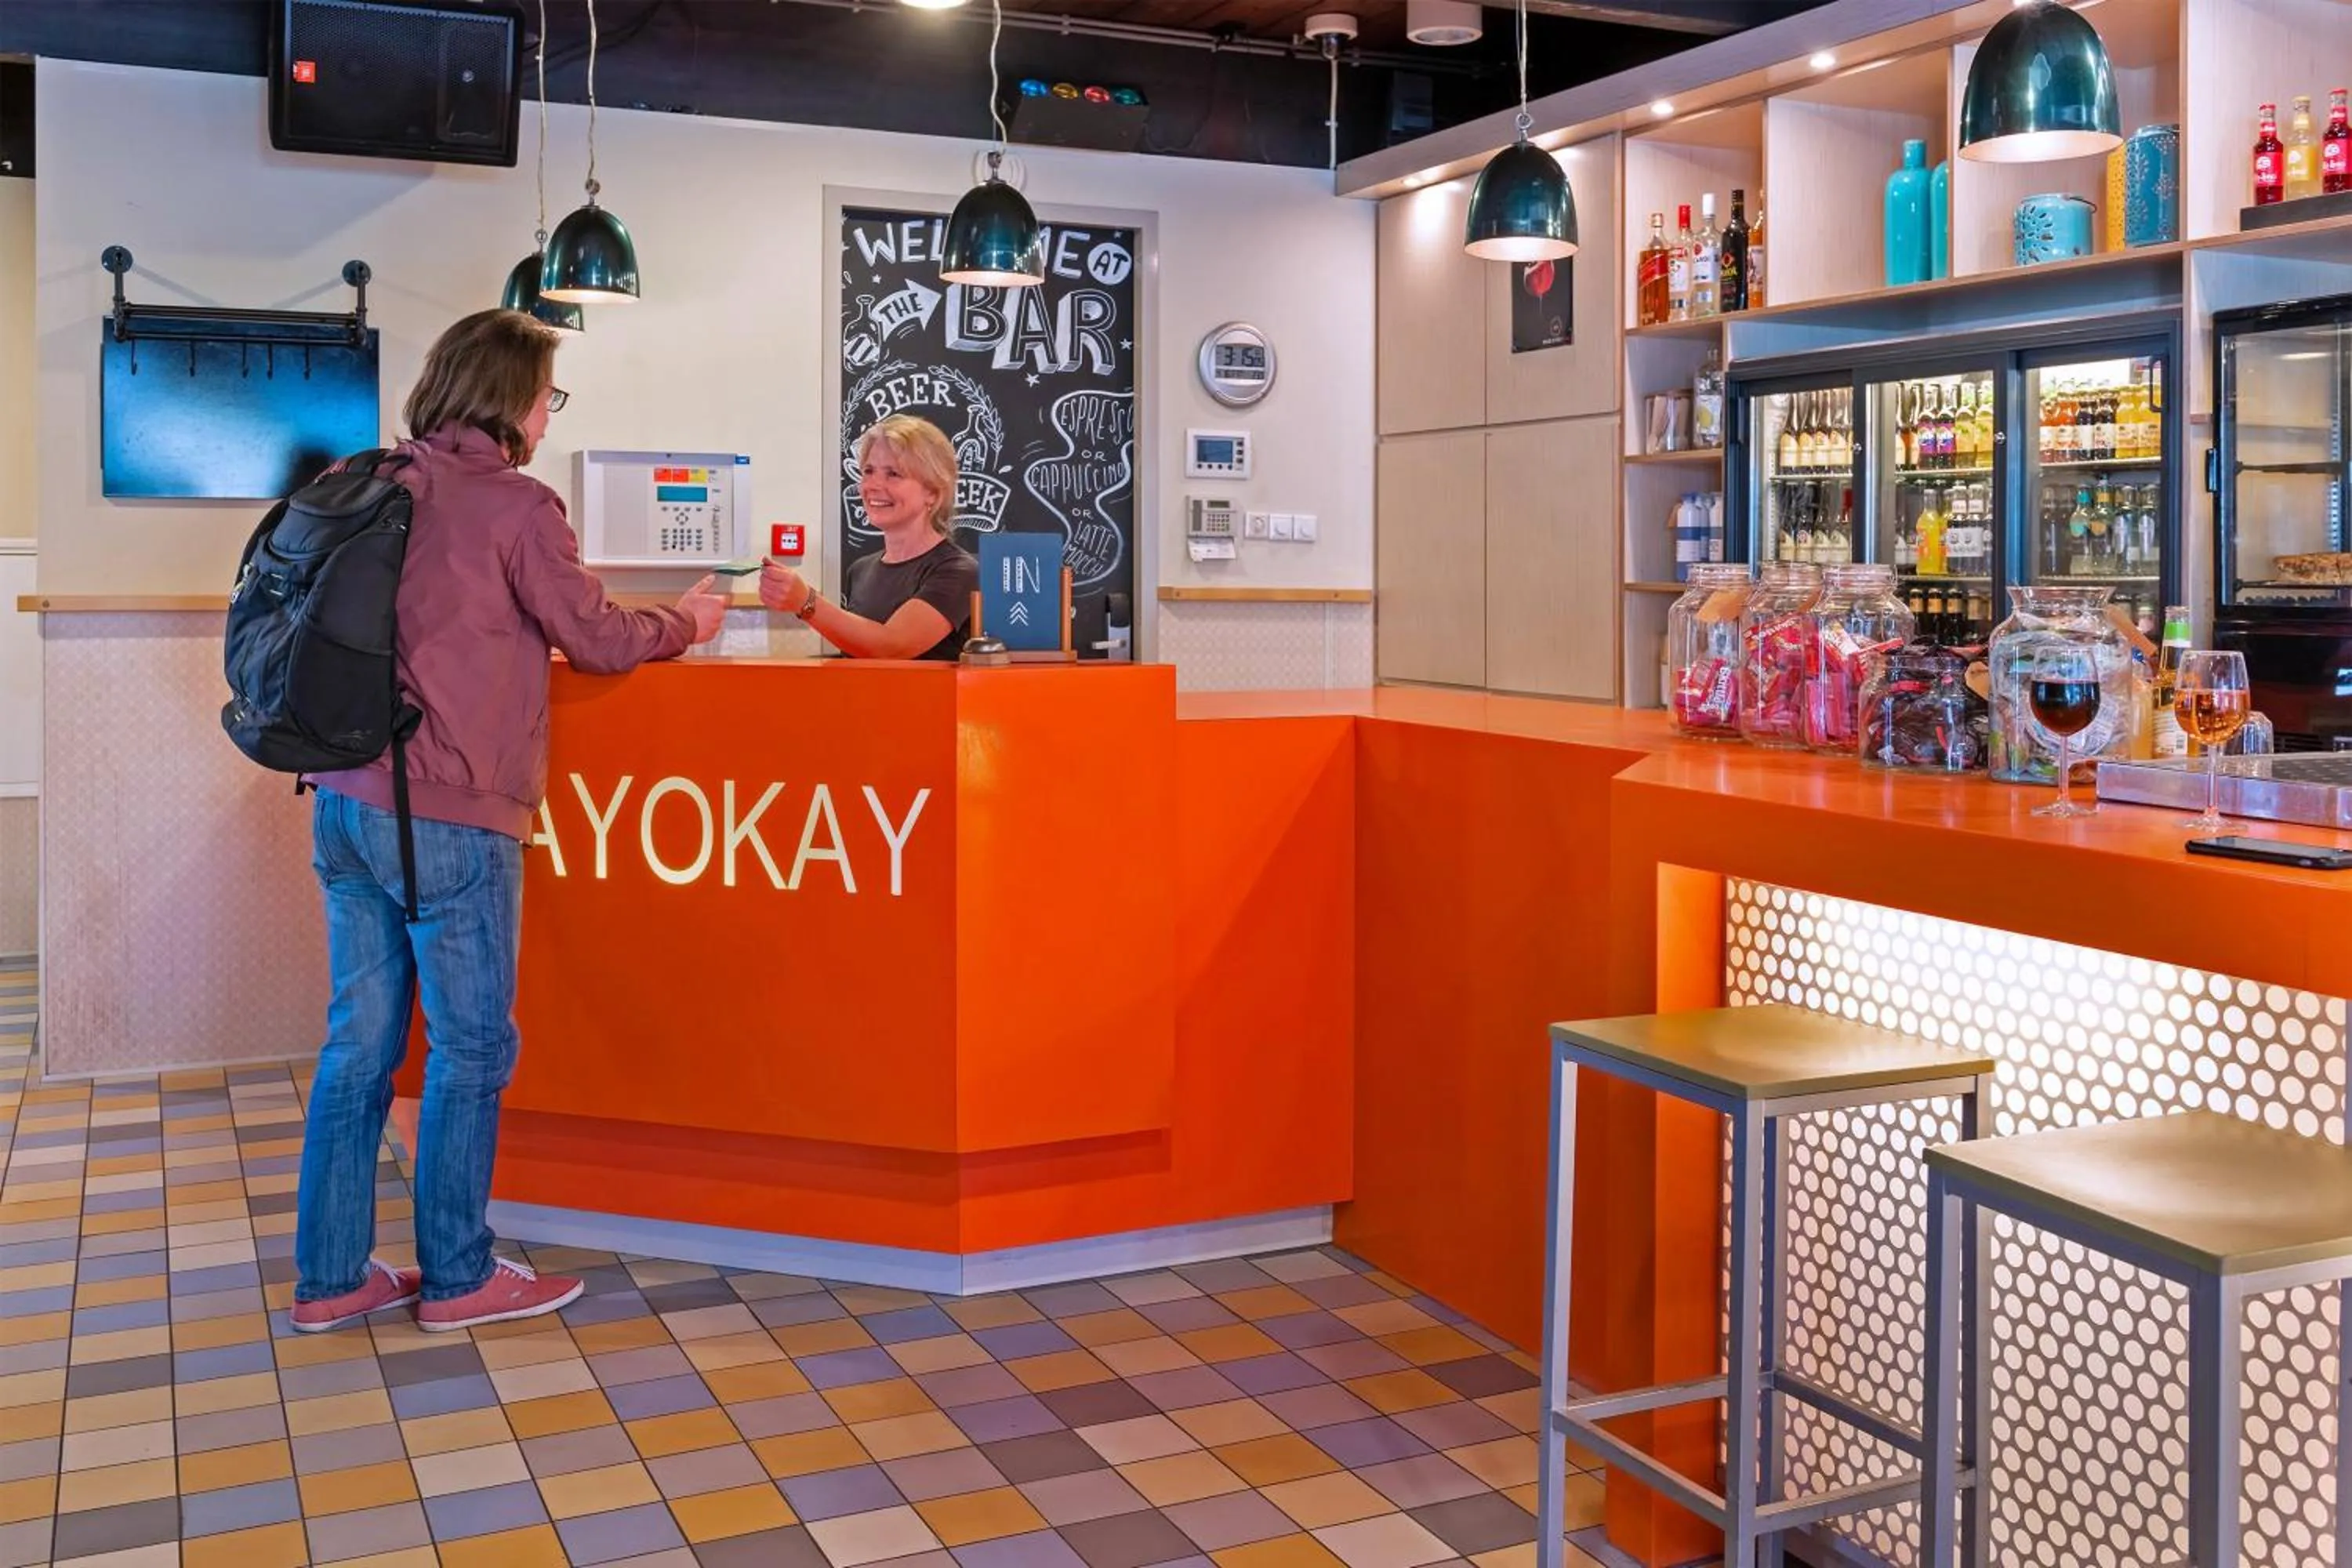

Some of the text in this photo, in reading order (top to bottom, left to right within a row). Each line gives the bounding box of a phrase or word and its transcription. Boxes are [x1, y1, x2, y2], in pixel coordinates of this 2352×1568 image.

[1092, 250, 1131, 274] AT
[879, 292, 924, 327] THE
[945, 284, 1116, 376] BAR
[865, 372, 957, 421] BEER
[1081, 449, 1107, 462] OR
[954, 479, 1004, 516] EEK
[1071, 507, 1094, 520] OR
[1073, 520, 1116, 561] LATTE
[1002, 556, 1040, 593] IN
[532, 772, 932, 897] AYOKAY
